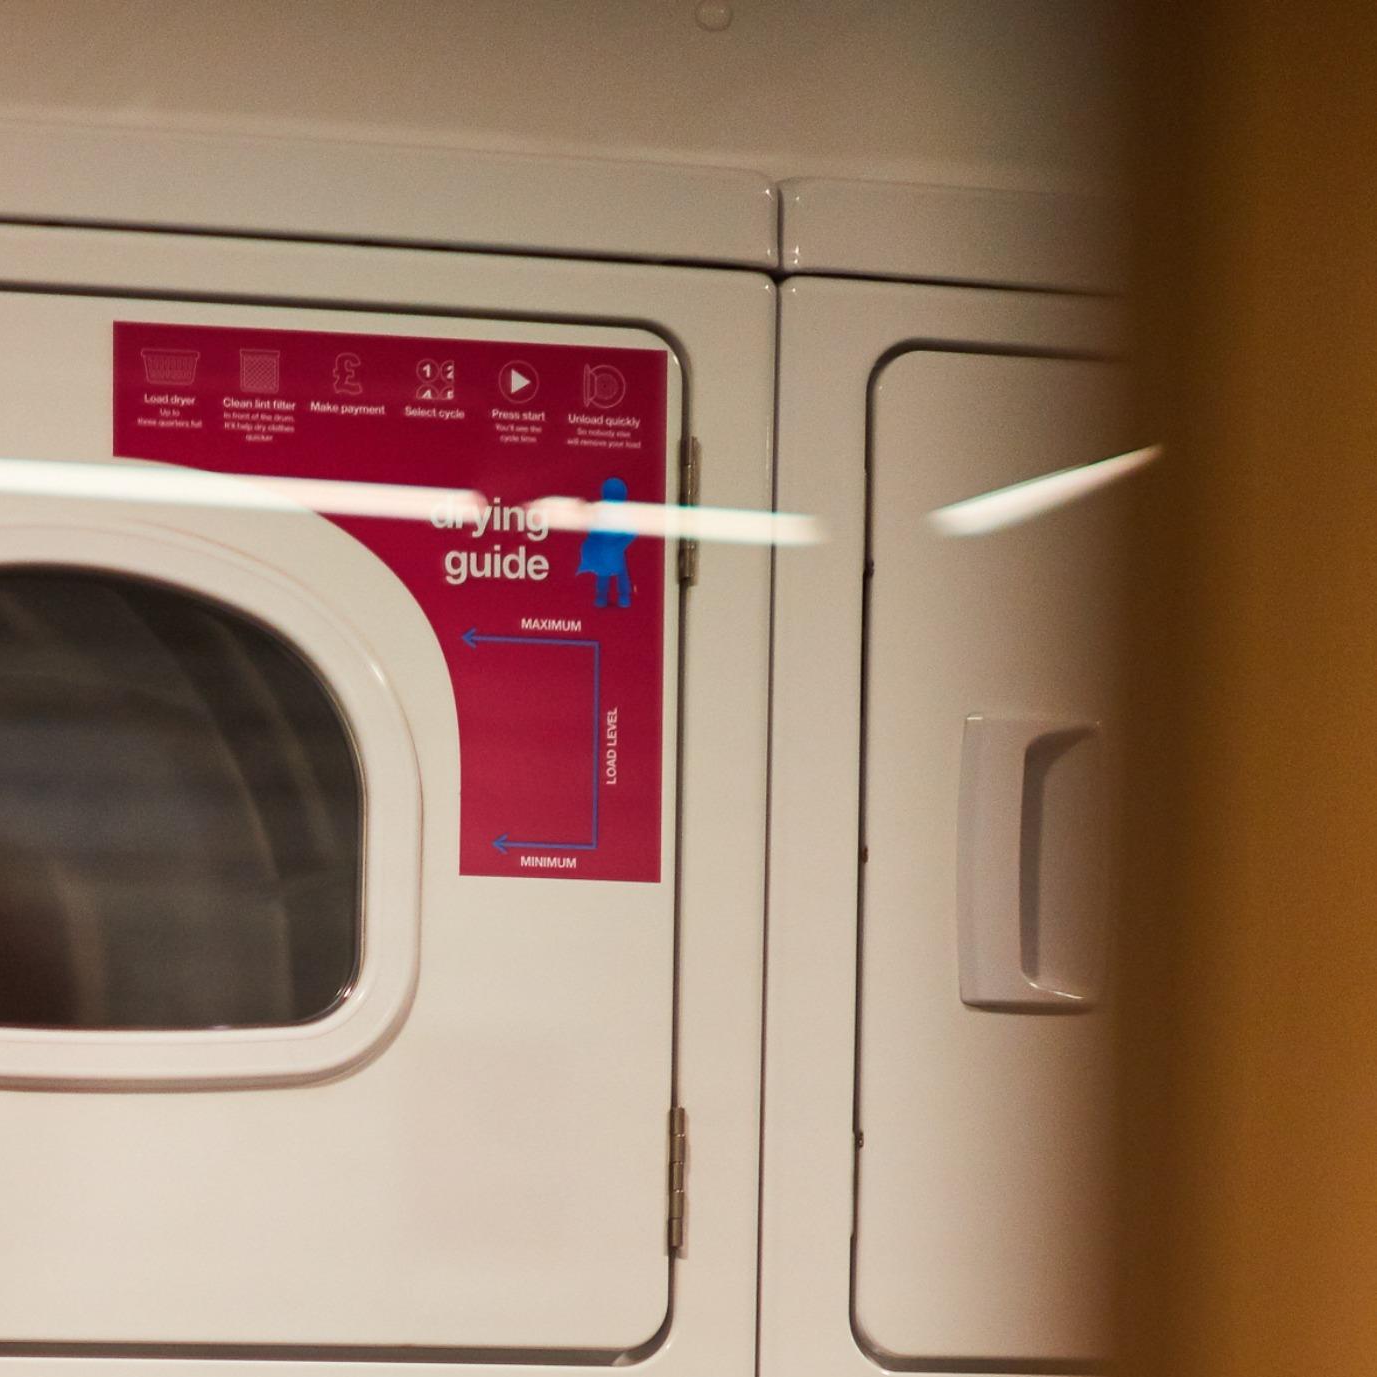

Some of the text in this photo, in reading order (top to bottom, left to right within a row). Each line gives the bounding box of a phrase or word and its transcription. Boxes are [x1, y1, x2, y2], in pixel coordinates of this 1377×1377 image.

[144, 393, 195, 406] Load dryer
[222, 397, 295, 410] Clean lint filter
[310, 401, 384, 415] Make payment
[404, 406, 464, 420] Select cycle
[491, 408, 545, 421] Press start
[568, 413, 640, 429] Unload quickly
[444, 547, 549, 585] guide
[521, 618, 582, 632] MAXIMUM
[606, 707, 618, 785] LOAD LEVEL
[520, 856, 577, 869] MINIMUM
